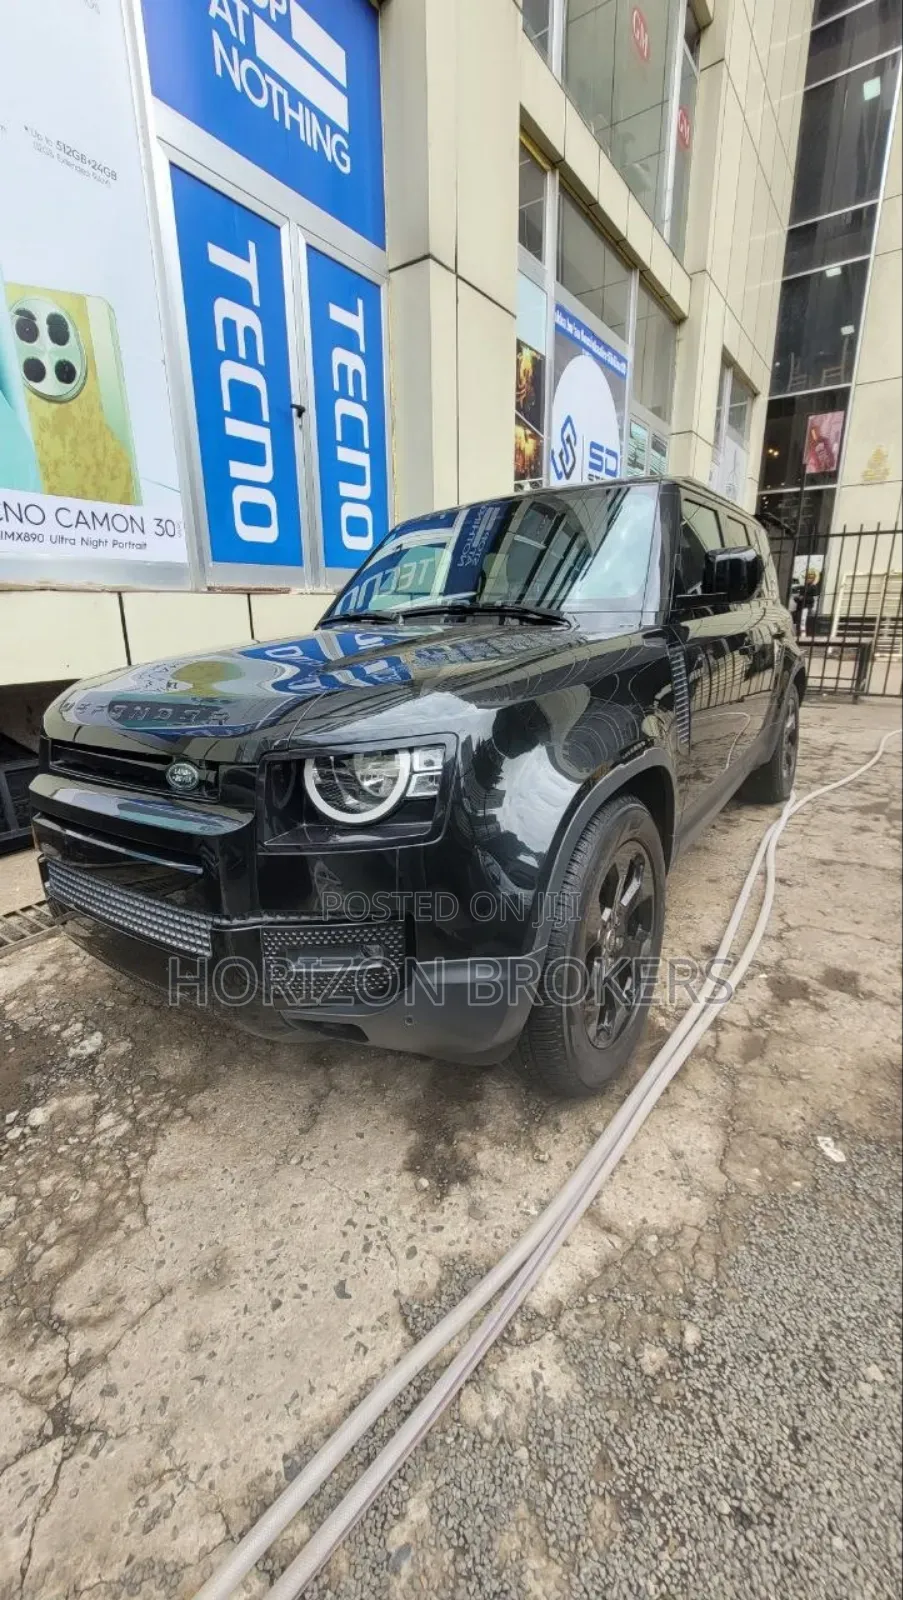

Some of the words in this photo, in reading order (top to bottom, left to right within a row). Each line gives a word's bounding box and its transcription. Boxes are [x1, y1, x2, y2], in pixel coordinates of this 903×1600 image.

[209, 0, 249, 45] AT
[212, 29, 351, 174] NOTHING
[56, 139, 117, 181] 512GB+24GB
[207, 240, 280, 543] TECNO
[329, 298, 374, 551] TECNO
[588, 441, 619, 478] SD
[1, 531, 44, 543] IMX890
[50, 535, 76, 546] Ultra
[80, 537, 109, 549] Night
[112, 539, 147, 550] Portrait
[55, 507, 145, 535] CAMON
[153, 518, 176, 538] 30
